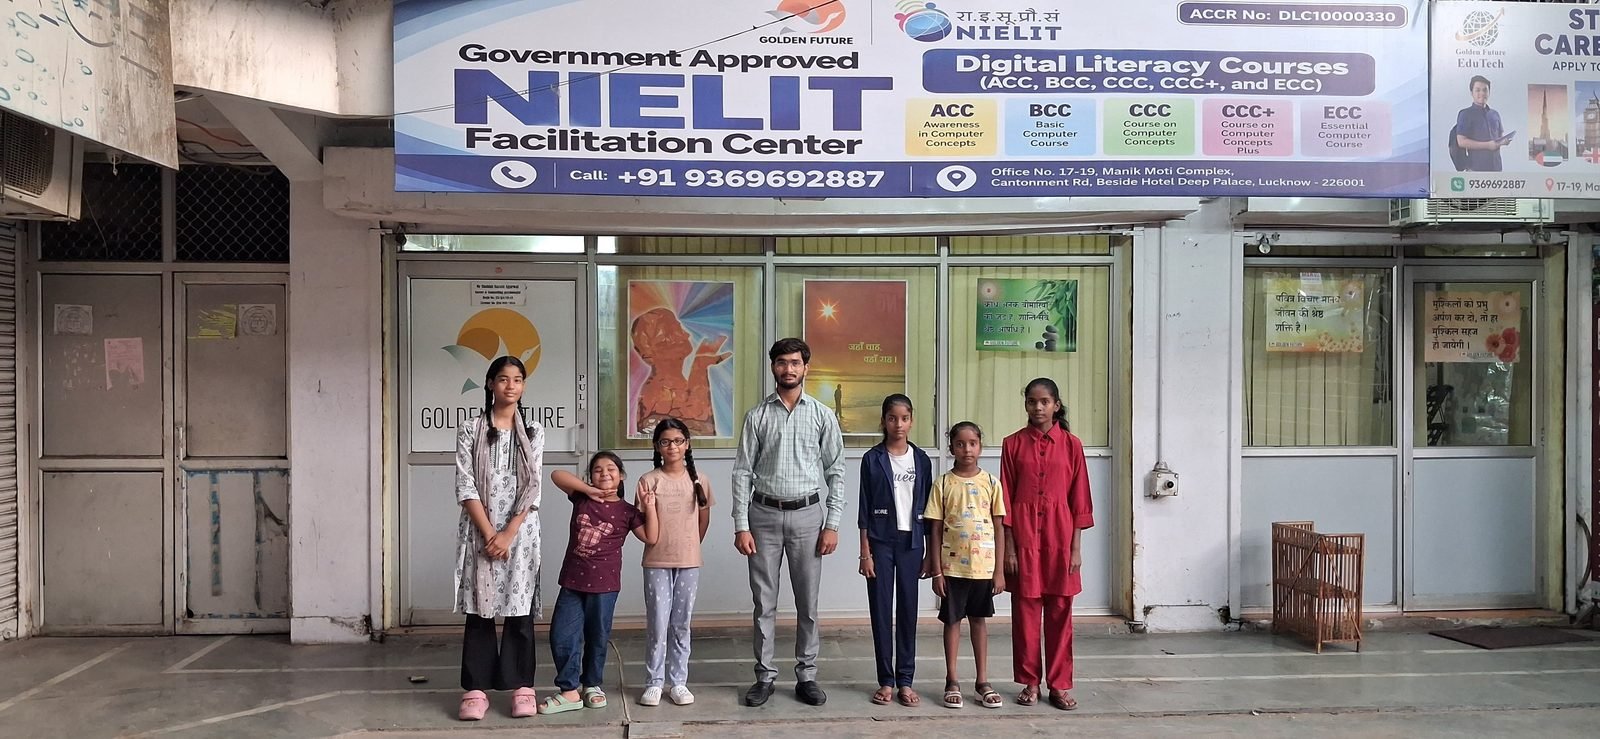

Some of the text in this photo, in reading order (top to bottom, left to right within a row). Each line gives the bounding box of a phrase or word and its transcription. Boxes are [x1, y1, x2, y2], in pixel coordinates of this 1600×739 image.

[1189, 8, 1396, 22] ACCR No: DLC10000330
[1568, 8, 1600, 30] ST
[956, 25, 1062, 41] NIELIT
[759, 36, 854, 45] GOLDEN FUTURE
[1534, 33, 1600, 56] CARE
[1455, 48, 1481, 56] Golden
[457, 43, 859, 73] Government Approved
[1457, 58, 1504, 69] EduTech
[956, 53, 1349, 77] Digital Literacy Courses
[1552, 61, 1586, 71] APPLY
[980, 75, 1322, 92] (ACC, BCC, CCC, CCC+, and ECC)
[453, 68, 894, 132] NIELIT
[930, 103, 974, 117] ACC
[1029, 103, 1072, 117] BCC
[1129, 104, 1171, 118] CCC
[1222, 104, 1275, 118] CCC+
[1323, 106, 1362, 119] ECC
[923, 121, 980, 129] Awareness
[1035, 120, 1065, 128] Basic
[1123, 120, 1161, 128] Course
[1221, 121, 1259, 129] Course
[1320, 122, 1368, 130] Essential
[918, 130, 984, 140] in Computer
[1022, 130, 1078, 140] Computer
[1122, 129, 1177, 138] Computer
[1221, 129, 1275, 139] Computer
[1318, 131, 1372, 140] Computer
[464, 127, 864, 155] Facilitation Center
[926, 139, 976, 148] Concepts
[1030, 139, 1069, 147] Course
[1124, 138, 1175, 147] Concepts
[1222, 139, 1273, 148] Concepts
[1325, 140, 1363, 149] Course
[1237, 147, 1260, 155] Plus
[991, 167, 1234, 177] Office No. 17-19, Manik Moti Complex,
[569, 168, 886, 189] Call: +91 9369692887
[991, 178, 1070, 187] Cantonment
[1073, 178, 1093, 187] Rd,
[1096, 178, 1138, 186] Beside
[1141, 178, 1175, 186] Hotel
[1177, 178, 1210, 187] Deep
[1213, 178, 1255, 187] Palace,
[1258, 178, 1311, 187] Lucknow
[1321, 179, 1365, 187] 226001
[1469, 180, 1526, 189] 9369692887
[1557, 182, 1582, 192] 17-19,
[1276, 291, 1295, 303] पवित्र
[1297, 292, 1320, 303] विचार
[1432, 297, 1489, 311] मुश्किलों को प्रभु
[1275, 307, 1296, 317] जीवन
[1299, 307, 1309, 318] की
[1479, 312, 1488, 322] तो
[1490, 314, 1498, 322] हर
[1295, 321, 1301, 333] है
[1432, 325, 1478, 338] मुश्किल सहज
[1432, 338, 1440, 350] हो
[421, 407, 565, 428] GOLDE TURE
[893, 473, 915, 482] uee
